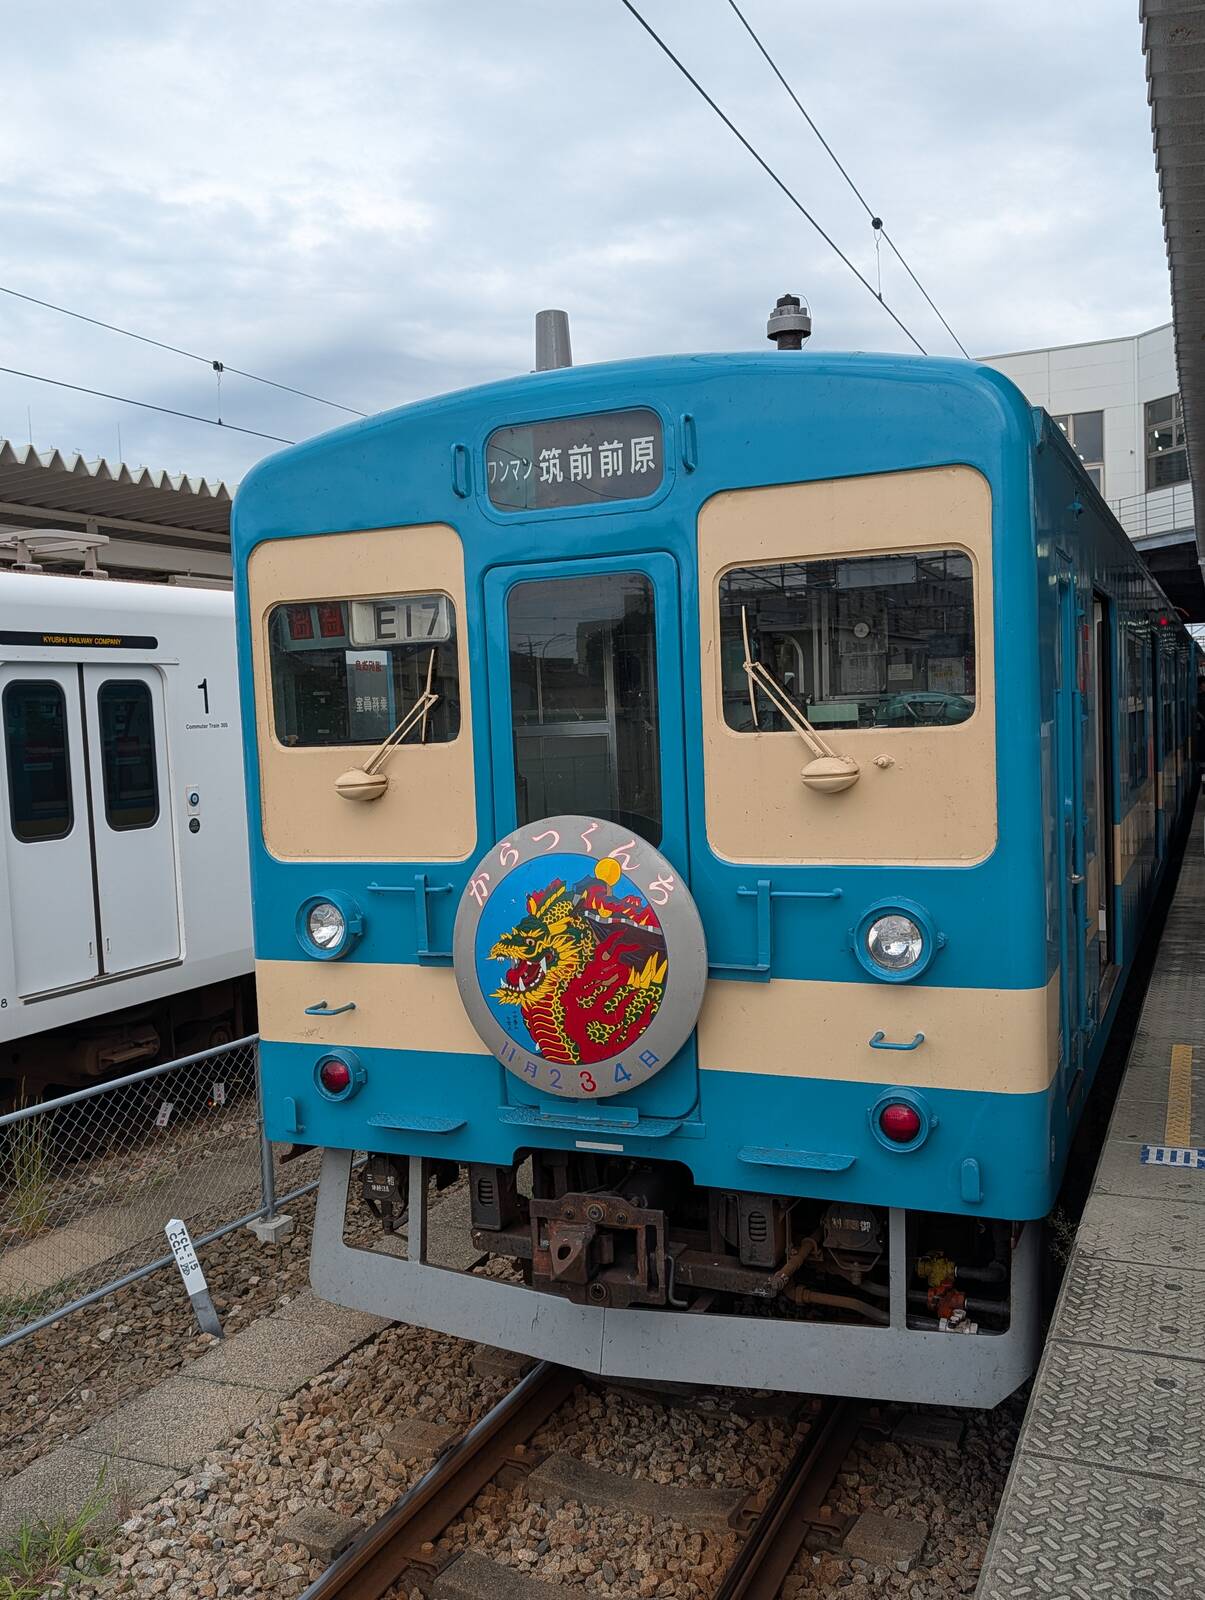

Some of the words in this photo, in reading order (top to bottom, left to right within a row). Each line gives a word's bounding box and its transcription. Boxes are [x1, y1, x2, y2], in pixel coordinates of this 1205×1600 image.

[488, 458, 532, 484] ワンマン
[539, 436, 656, 484] 筑前前原
[376, 603, 440, 639] E17
[43, 634, 67, 643] KYUSHU
[69, 636, 93, 645] RAILWAY
[94, 637, 122, 646] COMPANY
[197, 678, 209, 714] 1
[469, 822, 675, 907] からつくんち
